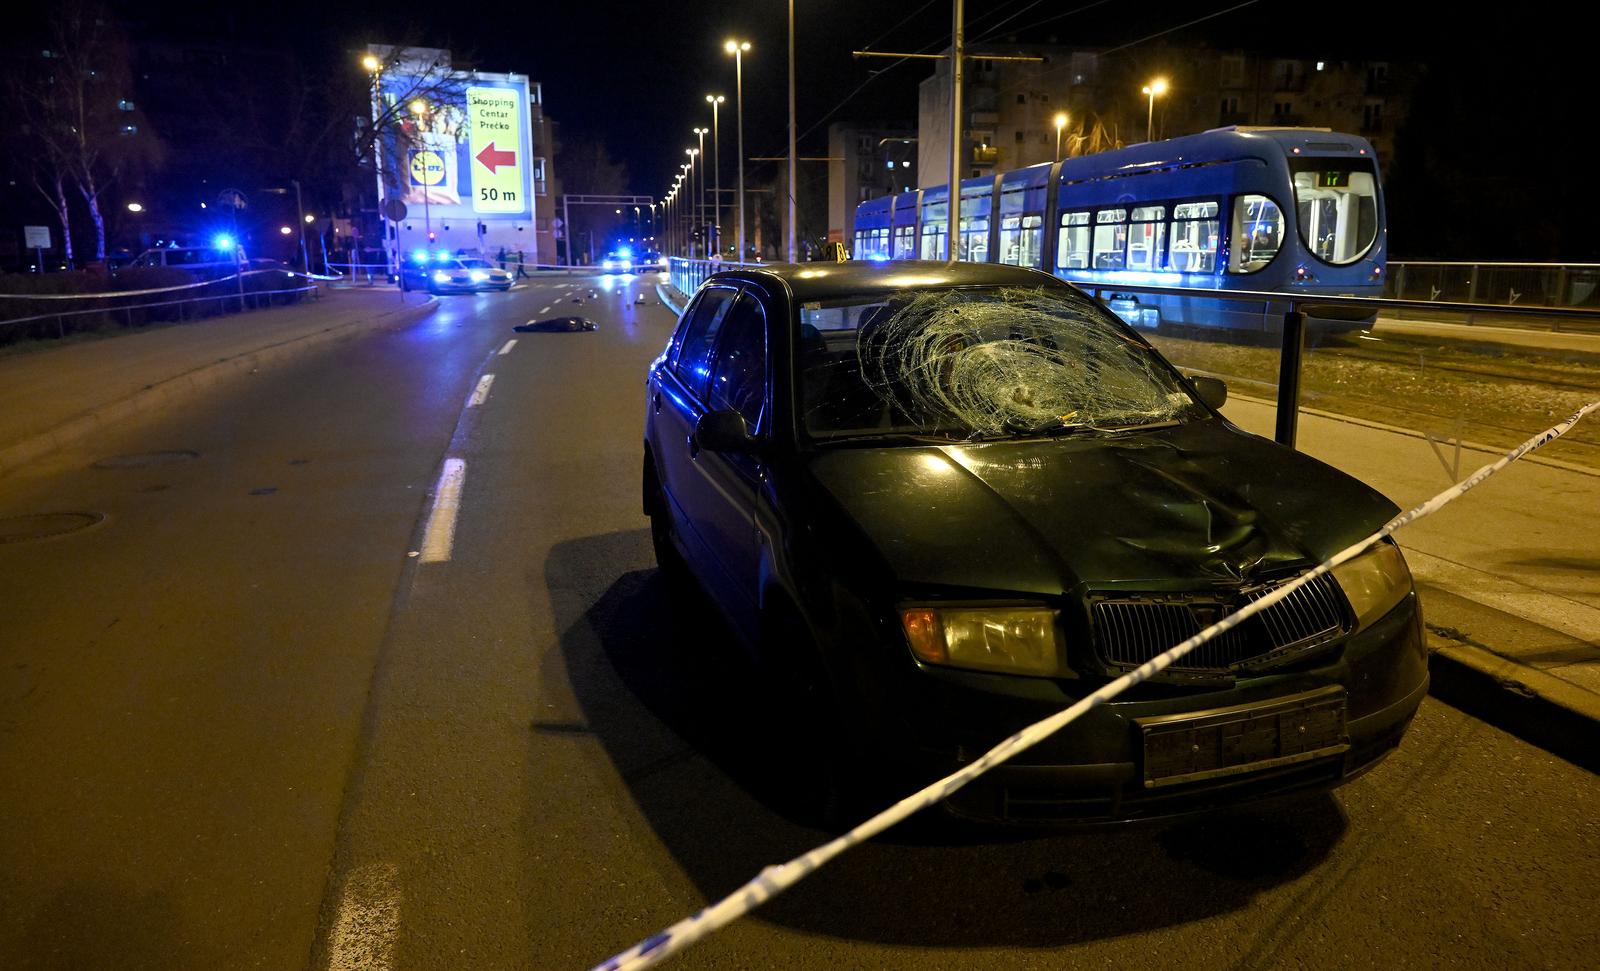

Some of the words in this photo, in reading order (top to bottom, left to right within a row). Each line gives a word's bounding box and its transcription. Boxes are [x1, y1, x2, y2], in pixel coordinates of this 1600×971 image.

[472, 96, 514, 109] Shopping
[480, 108, 508, 118] Centar
[481, 187, 498, 201] 50
[503, 191, 516, 201] m
